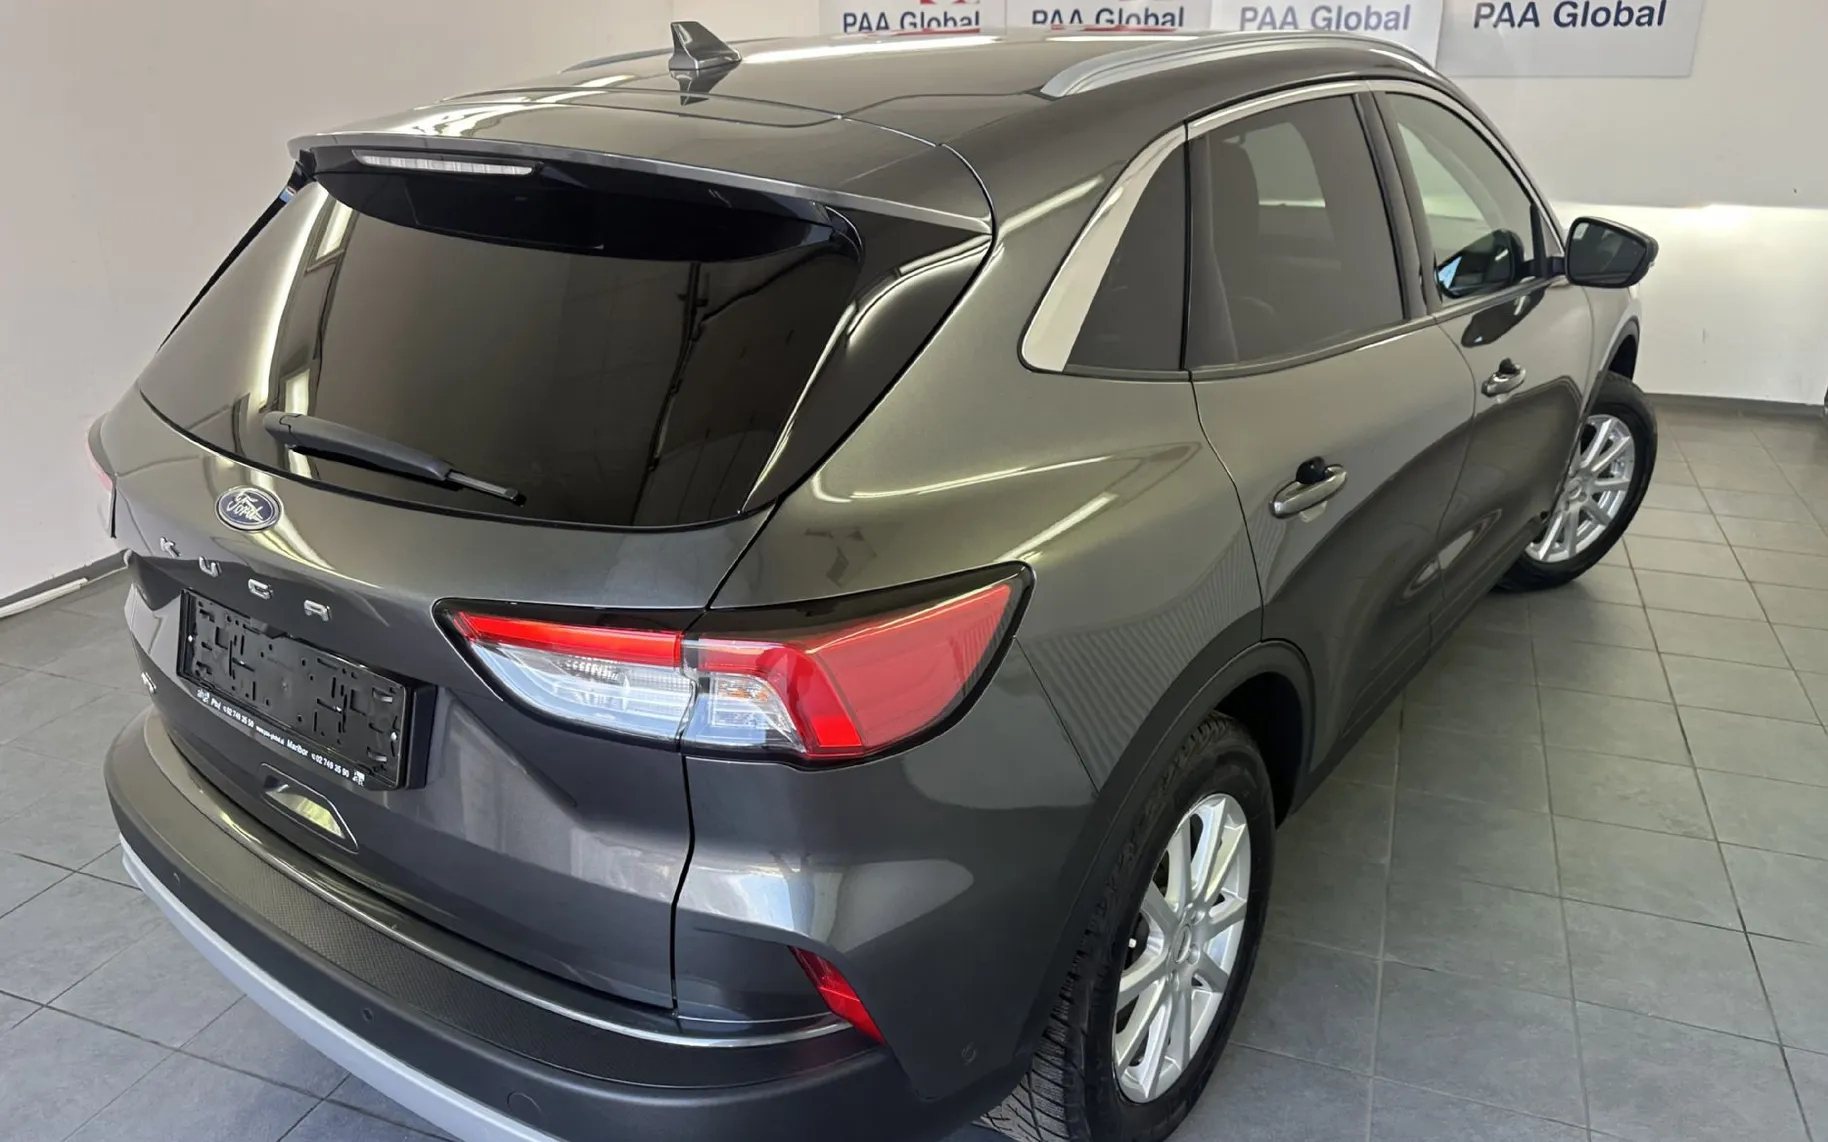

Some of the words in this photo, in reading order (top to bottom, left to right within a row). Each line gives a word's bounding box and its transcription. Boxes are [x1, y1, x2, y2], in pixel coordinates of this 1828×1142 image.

[843, 12, 890, 33] PAA
[900, 10, 980, 29] Global
[1032, 9, 1083, 25] PAA
[1095, 6, 1184, 27] Global
[1239, 6, 1299, 31] PAA
[1310, 4, 1411, 31] Global
[1473, 1, 1541, 28] PAA
[1552, 0, 1667, 28] Global
[226, 491, 264, 522] Ford
[160, 536, 332, 622] KUGA
